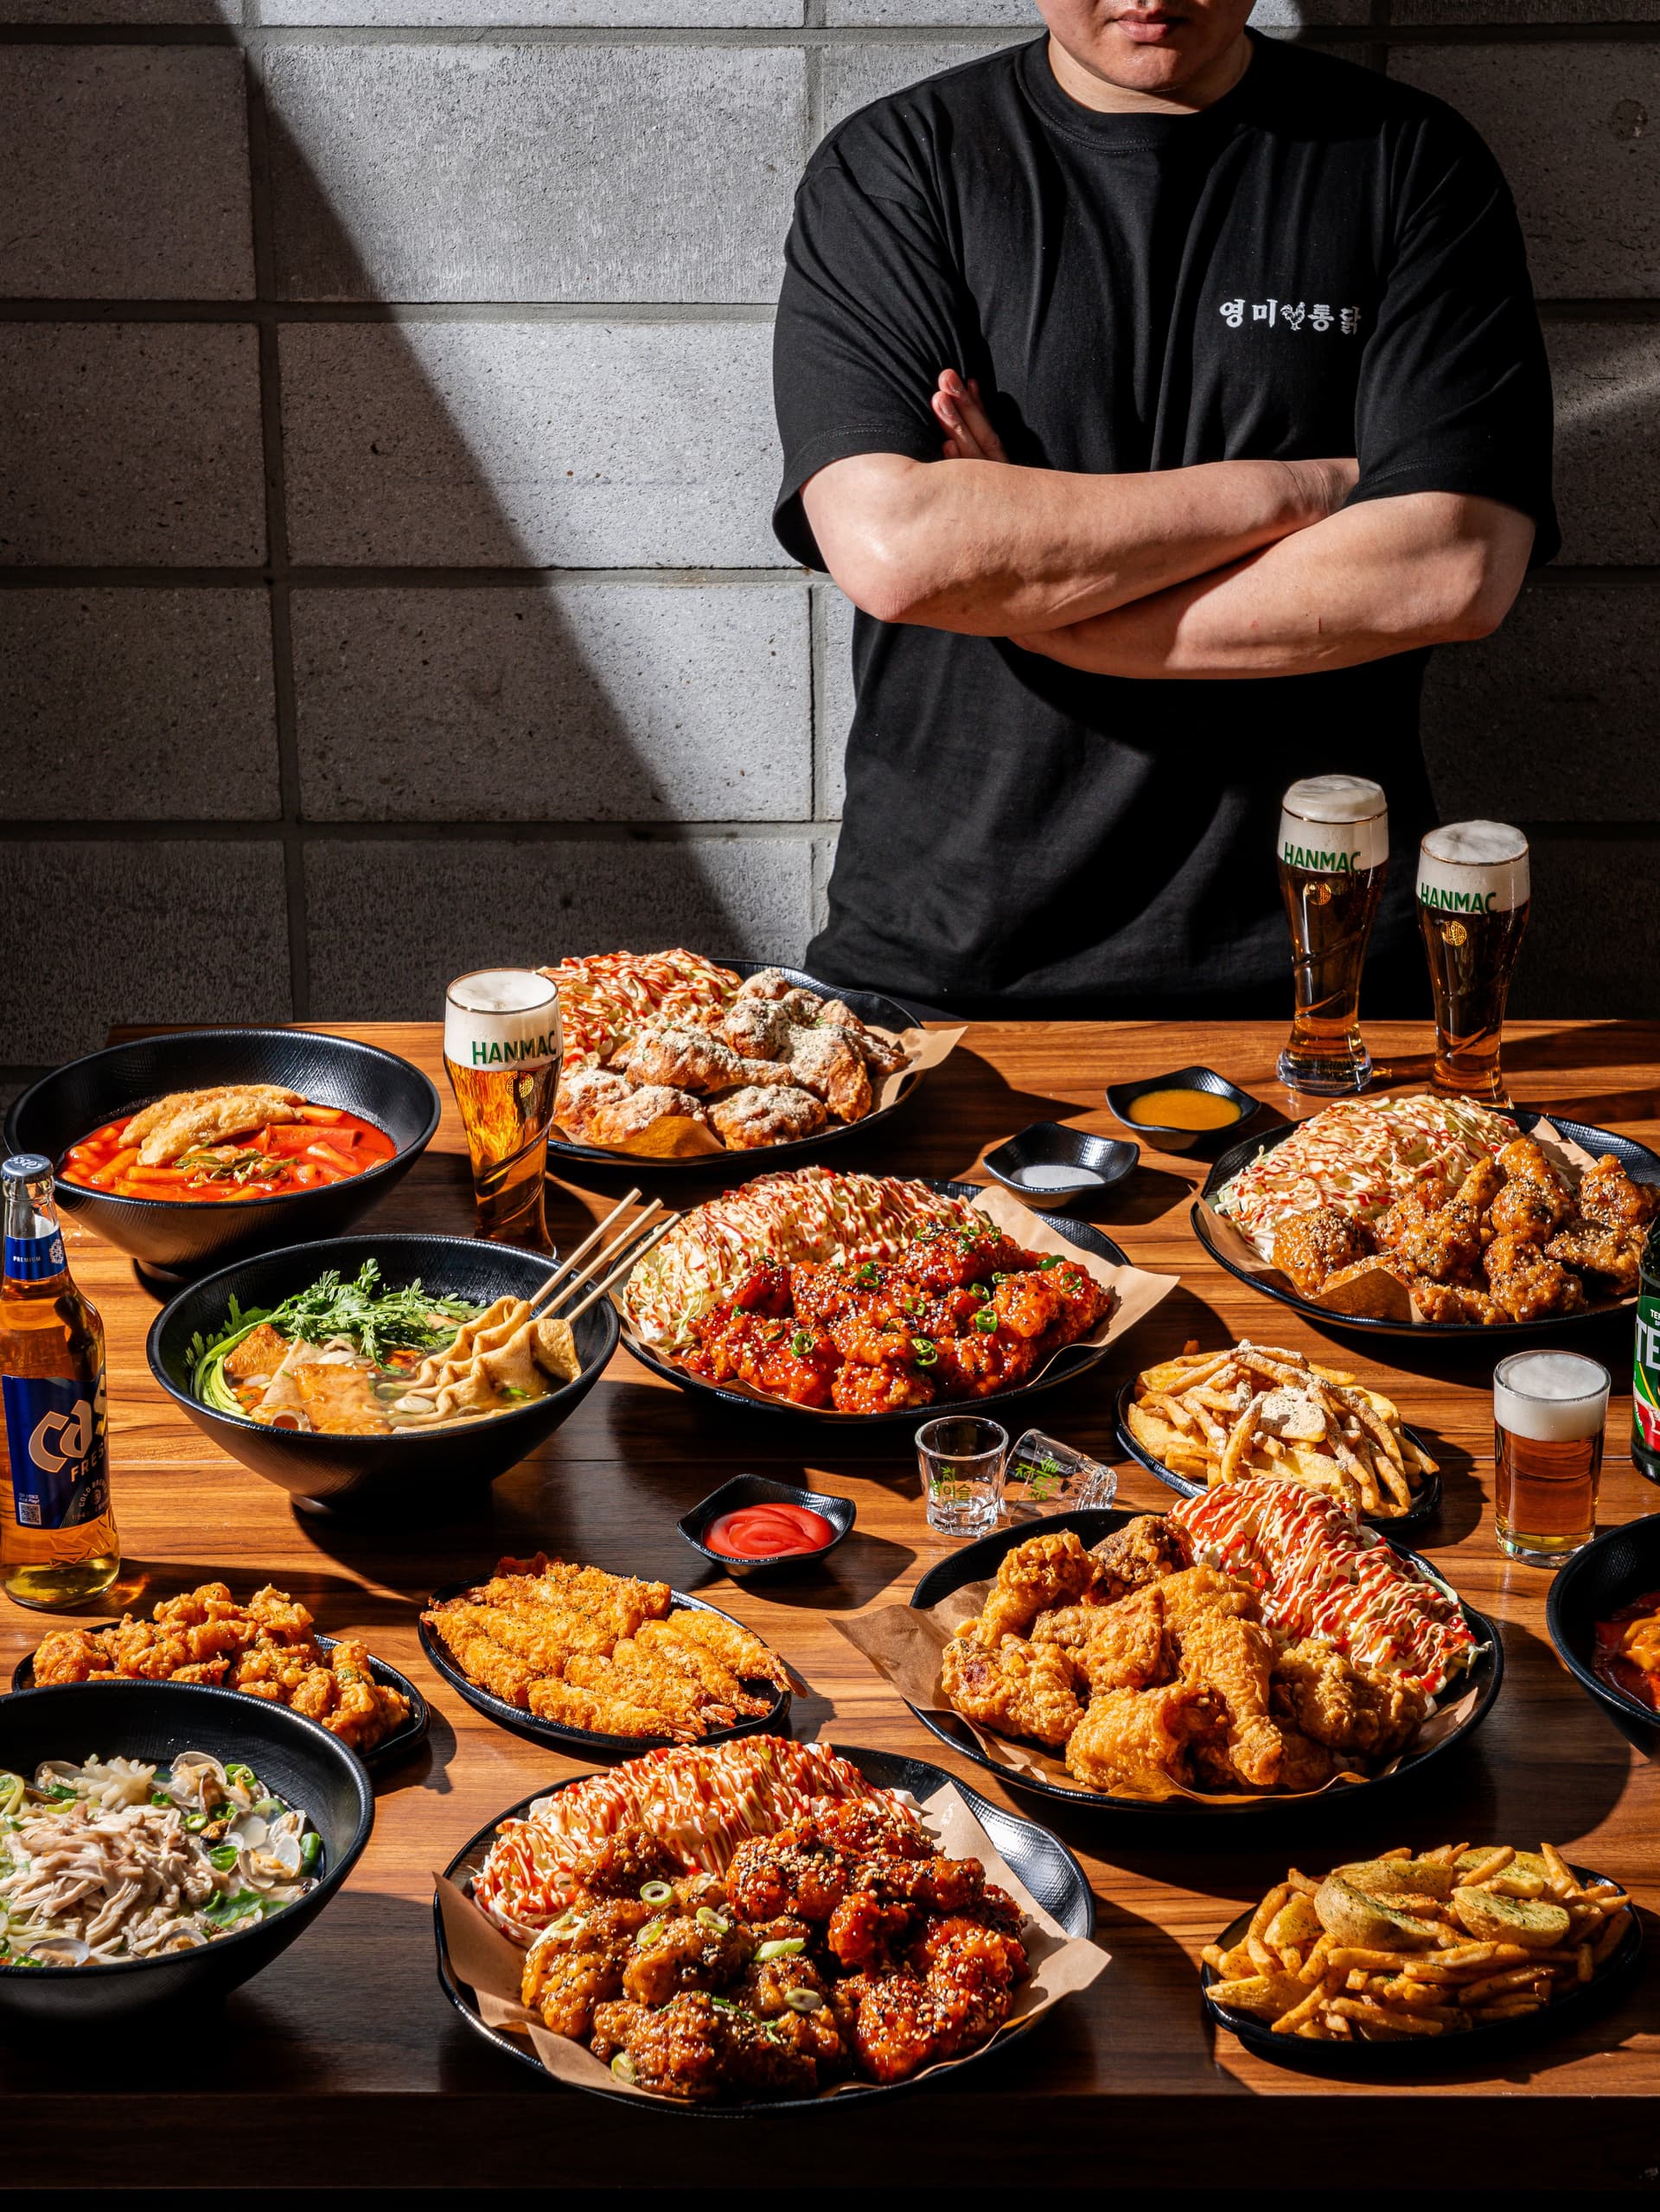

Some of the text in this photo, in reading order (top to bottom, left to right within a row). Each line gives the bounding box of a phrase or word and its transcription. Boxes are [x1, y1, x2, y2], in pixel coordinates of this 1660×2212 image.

[1219, 299, 1278, 329] 영미
[1284, 841, 1362, 873] HANMAC
[1420, 882, 1497, 913] HANMAC
[471, 1030, 557, 1065] HANMAC
[71, 1442, 105, 1482] FRES
